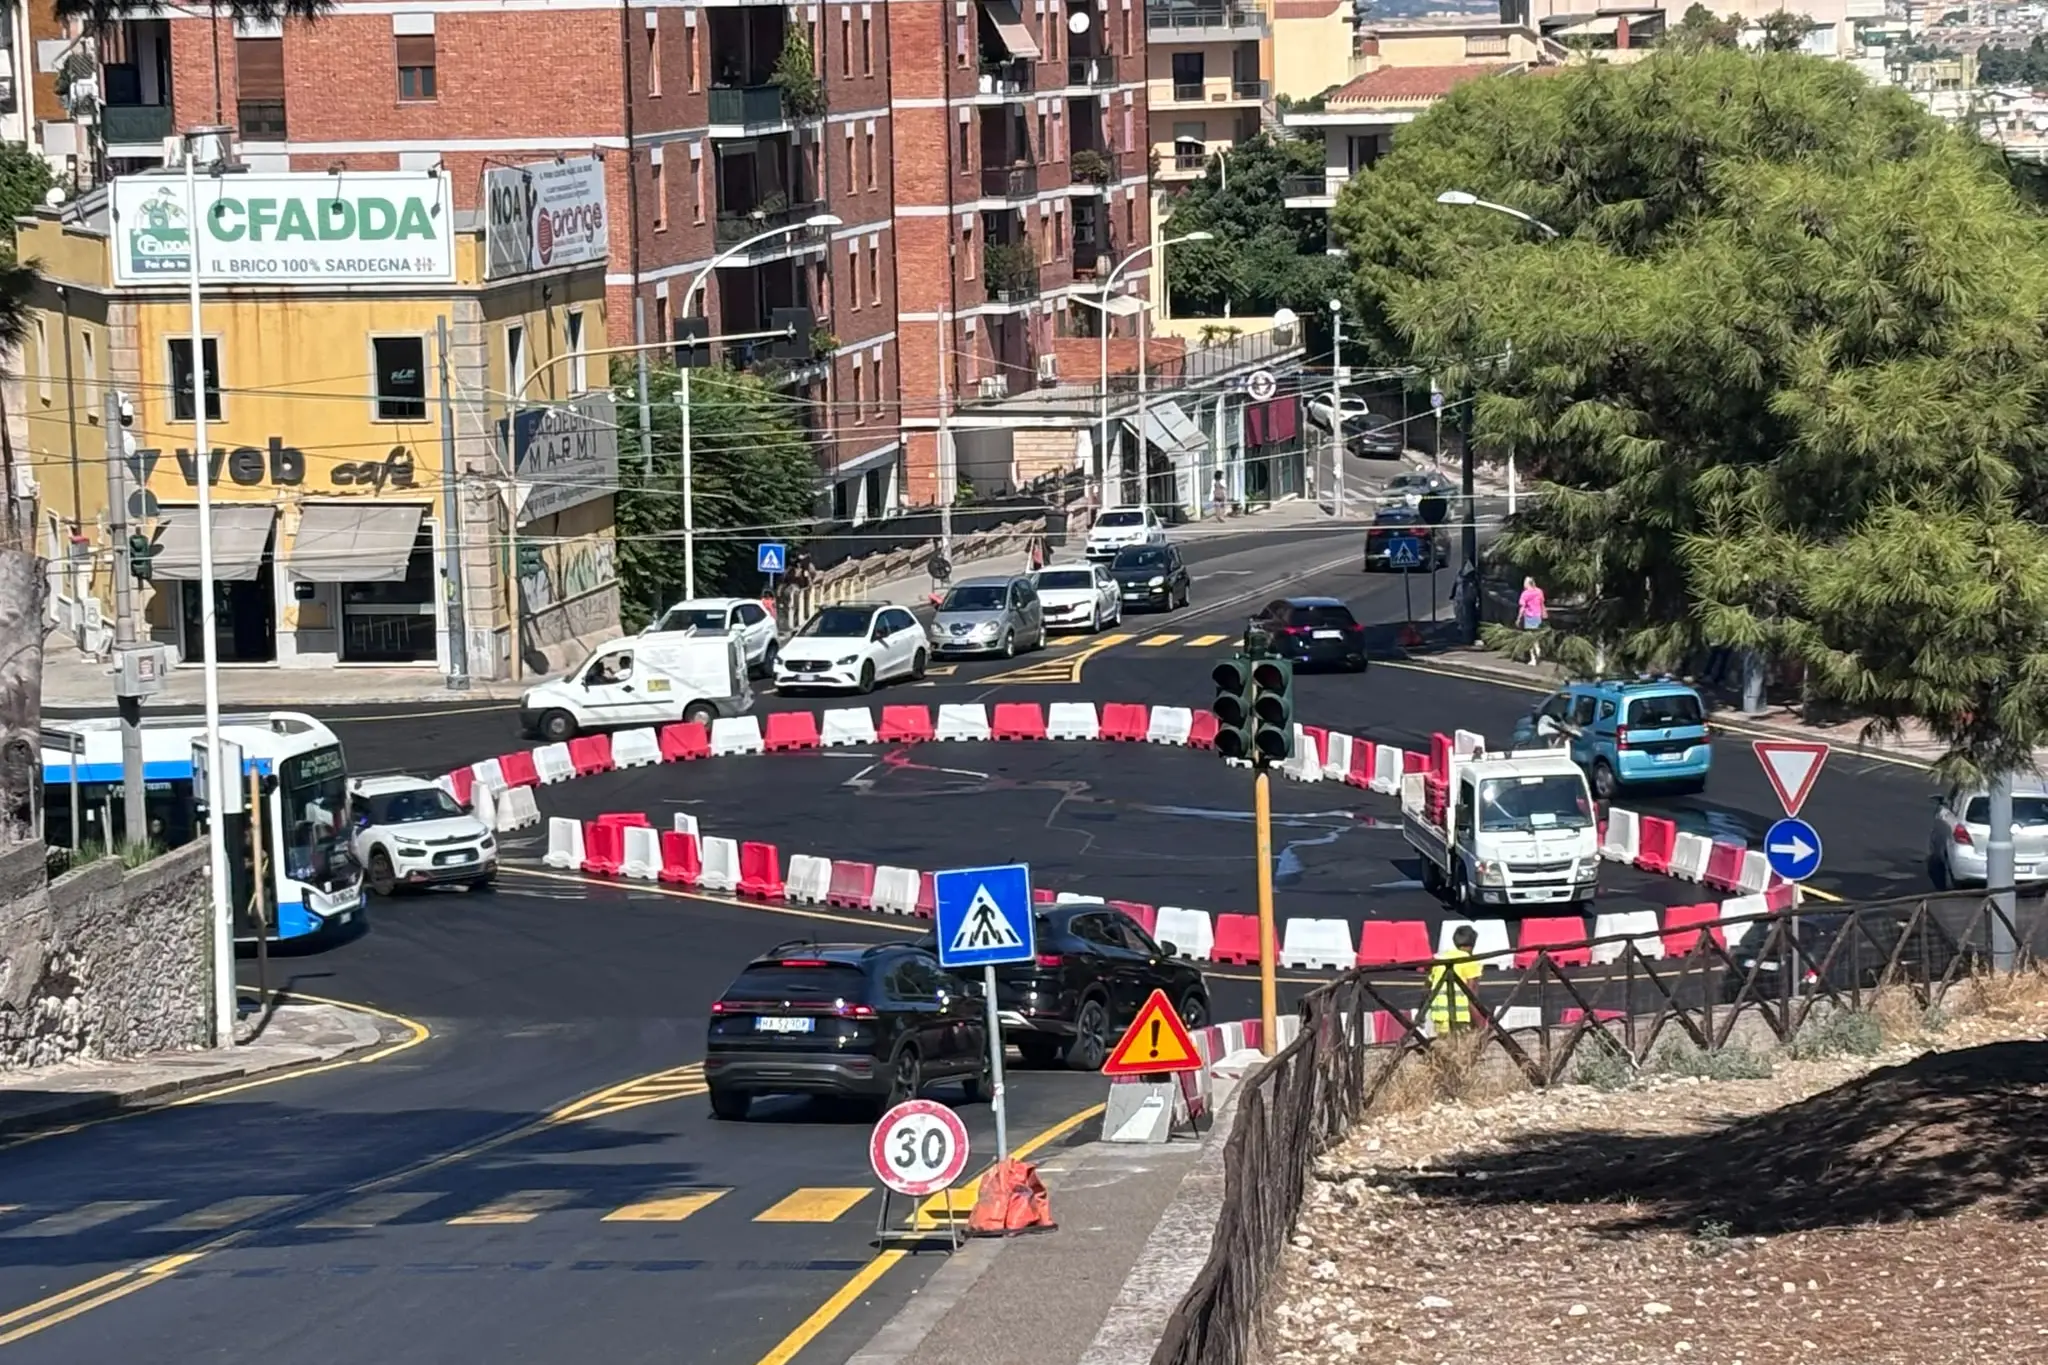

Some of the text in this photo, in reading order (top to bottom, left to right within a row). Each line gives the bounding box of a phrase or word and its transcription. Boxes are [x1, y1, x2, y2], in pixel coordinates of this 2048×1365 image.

[206, 198, 437, 242] CFADDA
[492, 186, 522, 226] NOA
[552, 202, 602, 243] orange
[212, 257, 412, 273] IL BRICO 100% SARDEGNA
[175, 437, 306, 487] web
[529, 430, 597, 474] MARMI
[894, 1127, 947, 1169] 30
